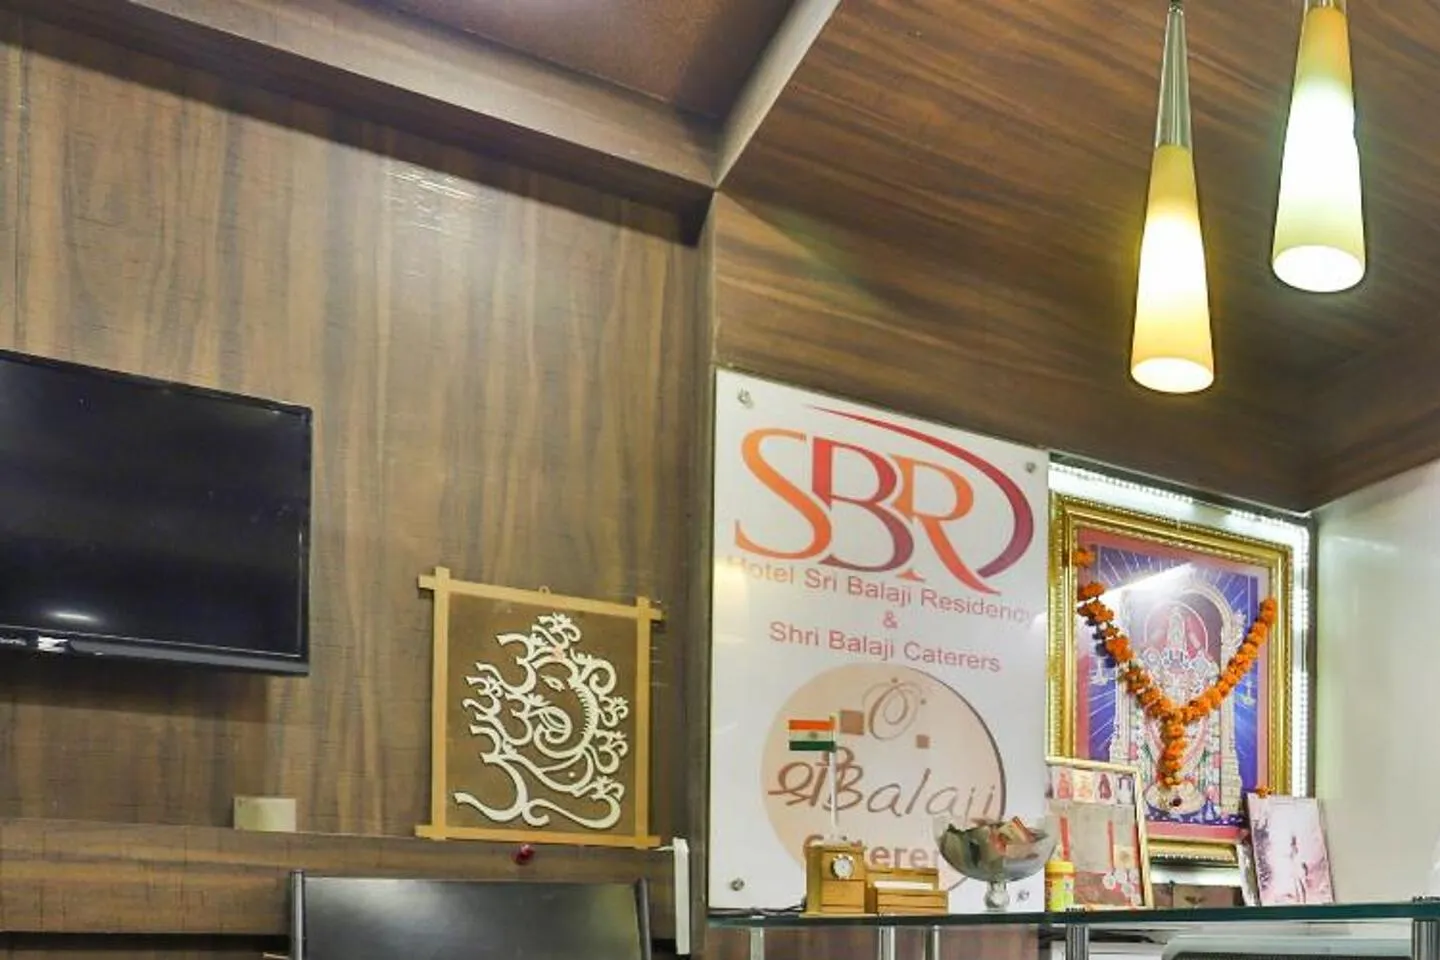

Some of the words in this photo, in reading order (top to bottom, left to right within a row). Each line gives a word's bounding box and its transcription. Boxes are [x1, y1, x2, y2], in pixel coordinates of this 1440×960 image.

[734, 427, 1003, 597] SBR
[803, 567, 838, 592] Sri
[847, 575, 912, 608] Balaji
[920, 587, 1036, 628] Residency
[881, 610, 899, 630] &
[768, 620, 820, 647] Shri
[828, 630, 895, 662] Balaji
[903, 641, 1001, 673] Caterers
